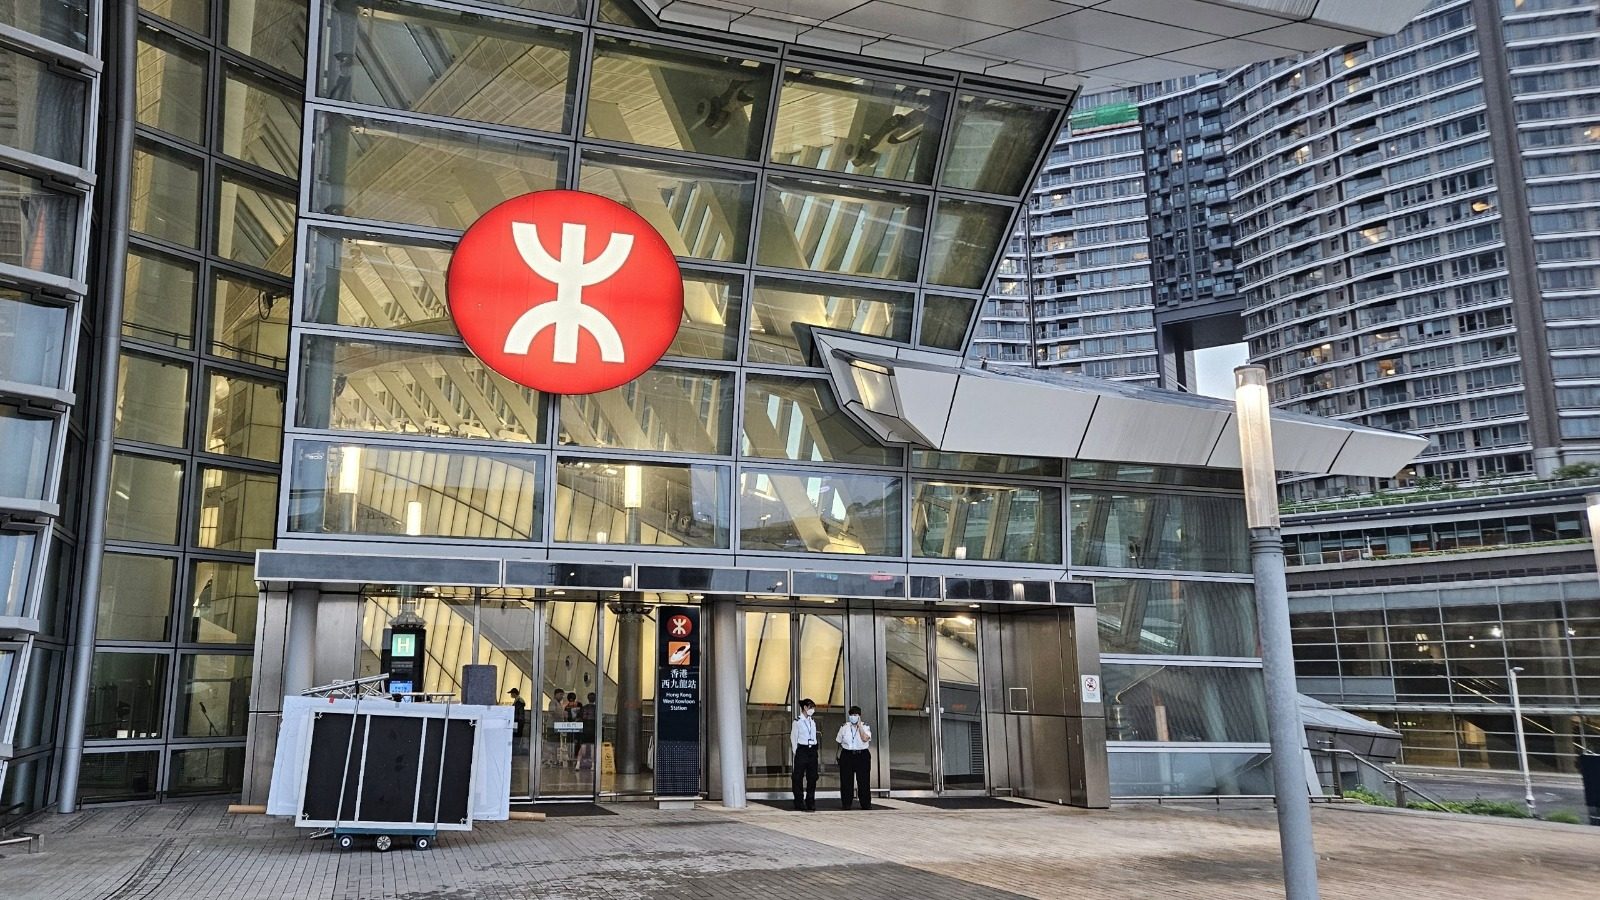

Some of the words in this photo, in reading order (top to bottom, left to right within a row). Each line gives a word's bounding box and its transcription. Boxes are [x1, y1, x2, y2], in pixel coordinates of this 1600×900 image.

[397, 637, 410, 653] H
[670, 668, 688, 678] 香港
[661, 679, 697, 689] 西九龍站
